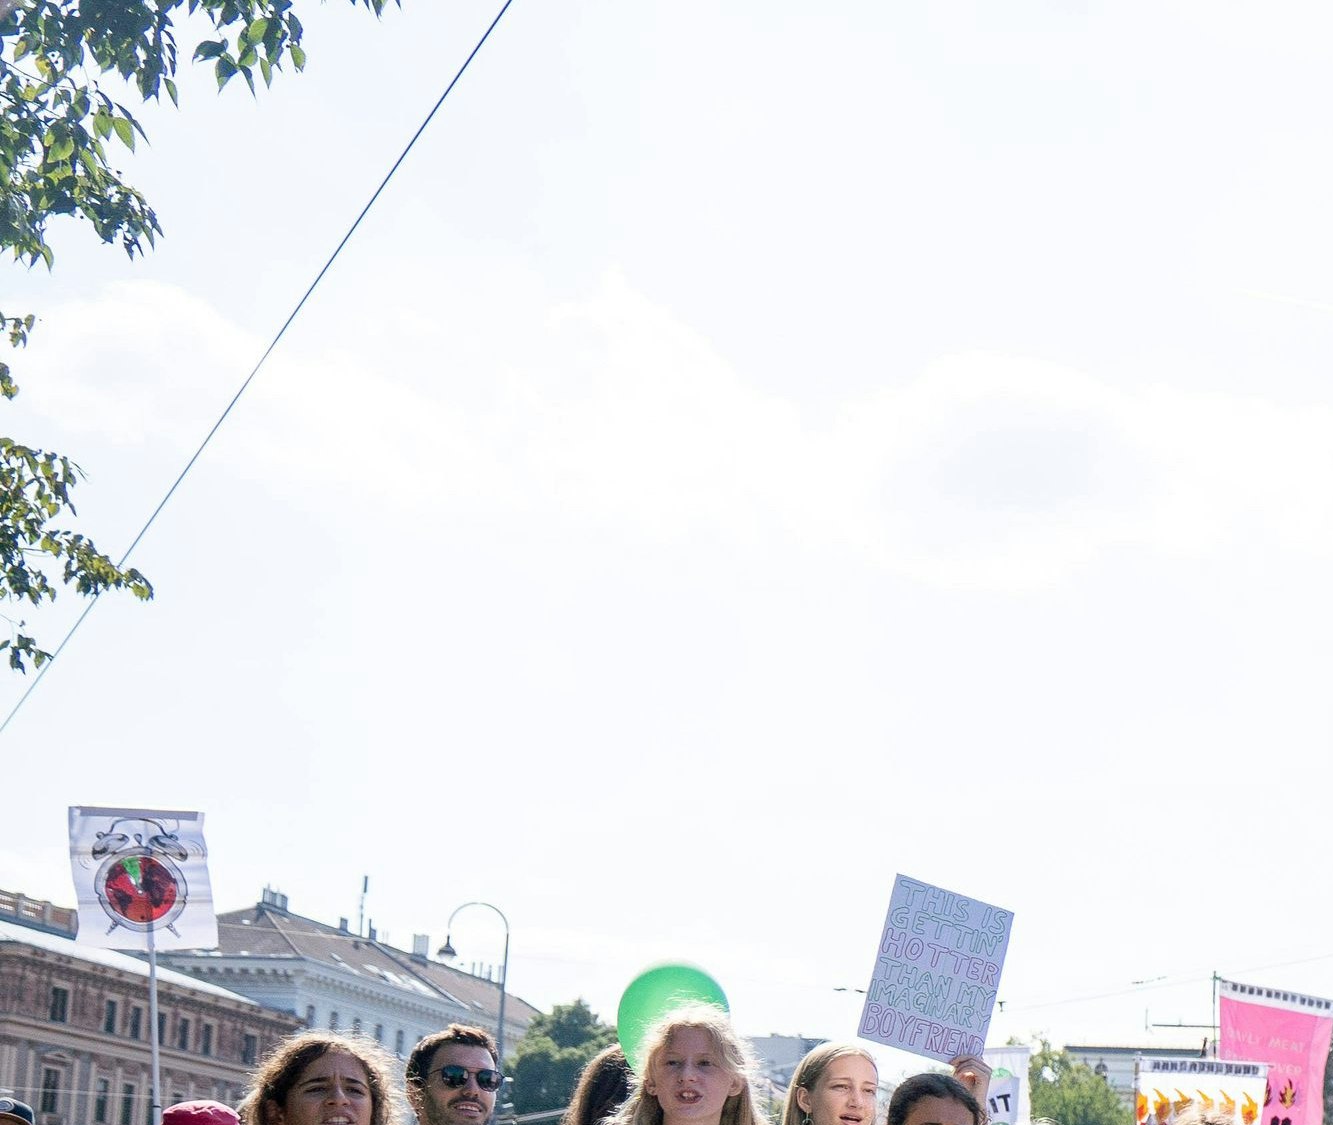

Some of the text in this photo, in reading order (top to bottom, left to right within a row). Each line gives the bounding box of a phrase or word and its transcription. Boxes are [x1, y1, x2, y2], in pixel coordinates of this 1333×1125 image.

[890, 907, 1004, 956] GETTIN'
[900, 880, 1007, 934] THIS IS
[880, 957, 997, 1011] THAN MY
[882, 928, 999, 987] HOTTER
[862, 1002, 985, 1057] BOYFRIEND
[868, 978, 991, 1032] IMAGINARY
